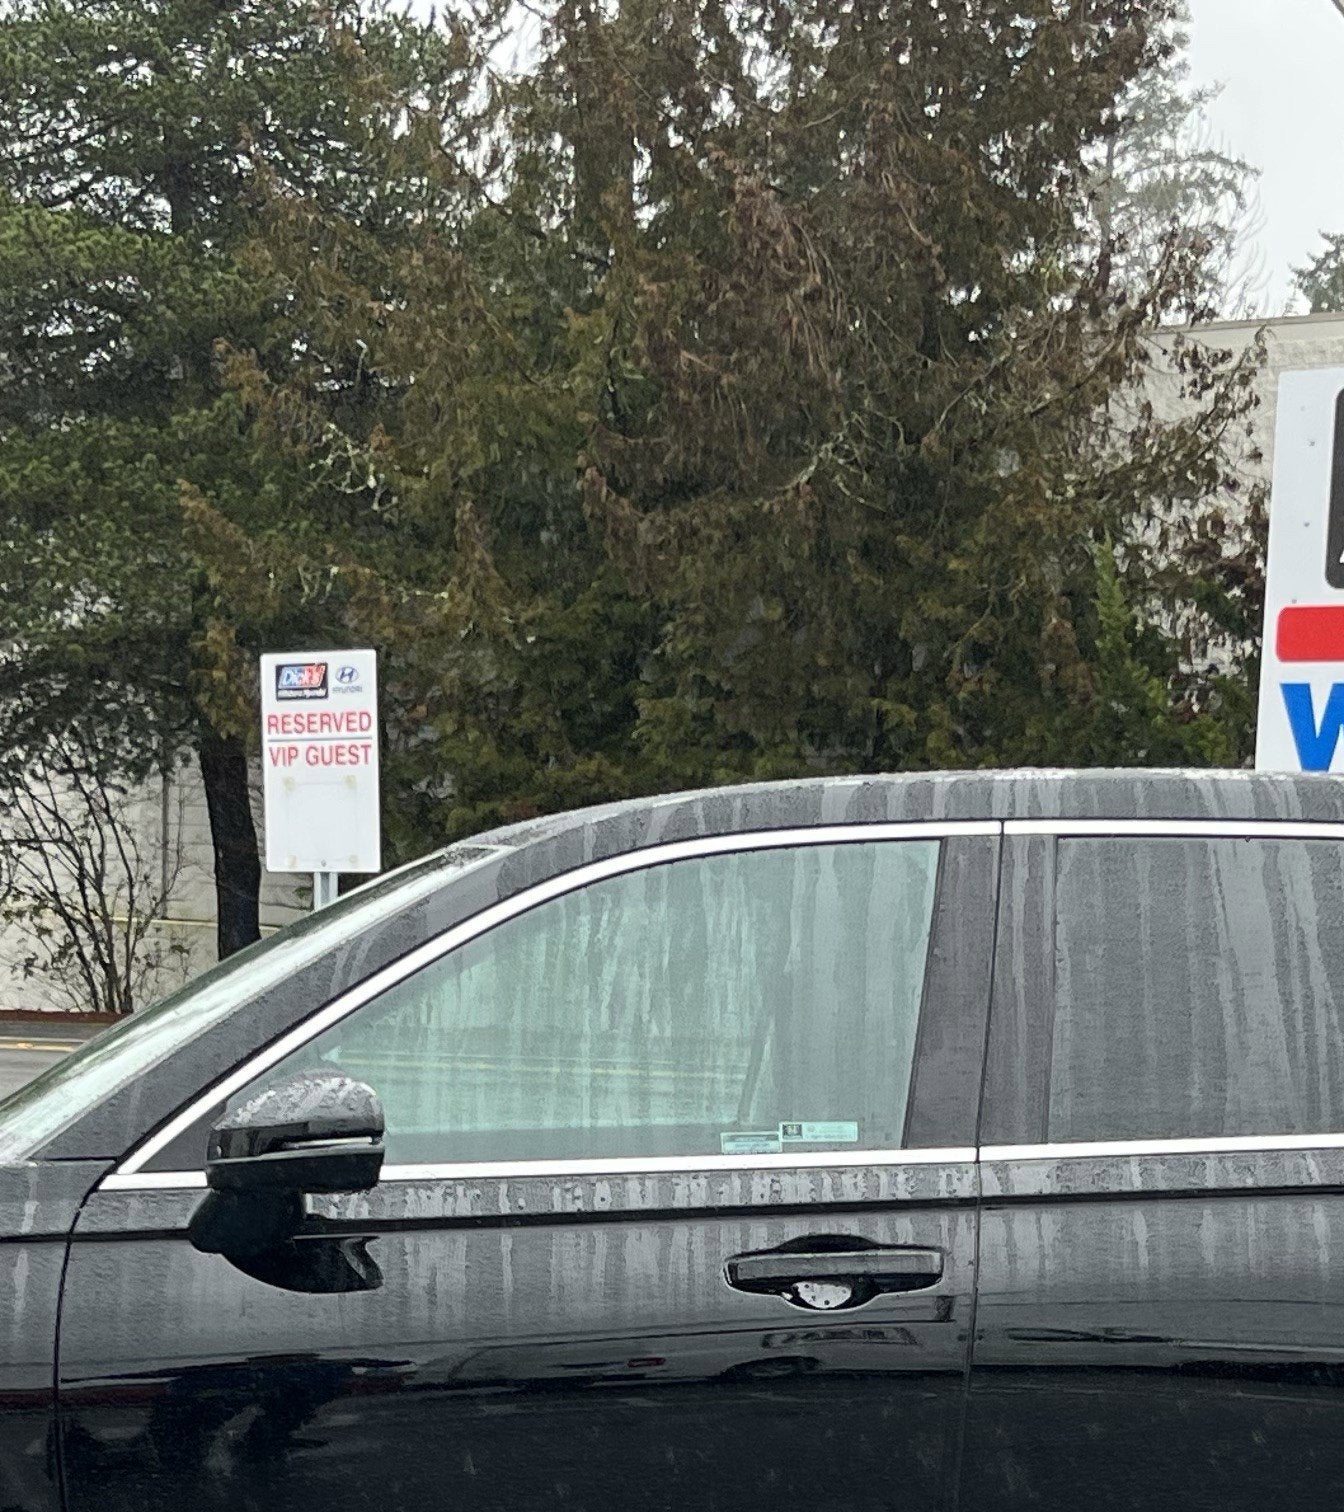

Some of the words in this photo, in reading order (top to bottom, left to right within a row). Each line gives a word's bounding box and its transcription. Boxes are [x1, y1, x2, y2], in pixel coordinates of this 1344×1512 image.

[267, 711, 372, 734] RESERVED
[268, 746, 299, 767] VIP
[305, 744, 372, 766] GUEST
